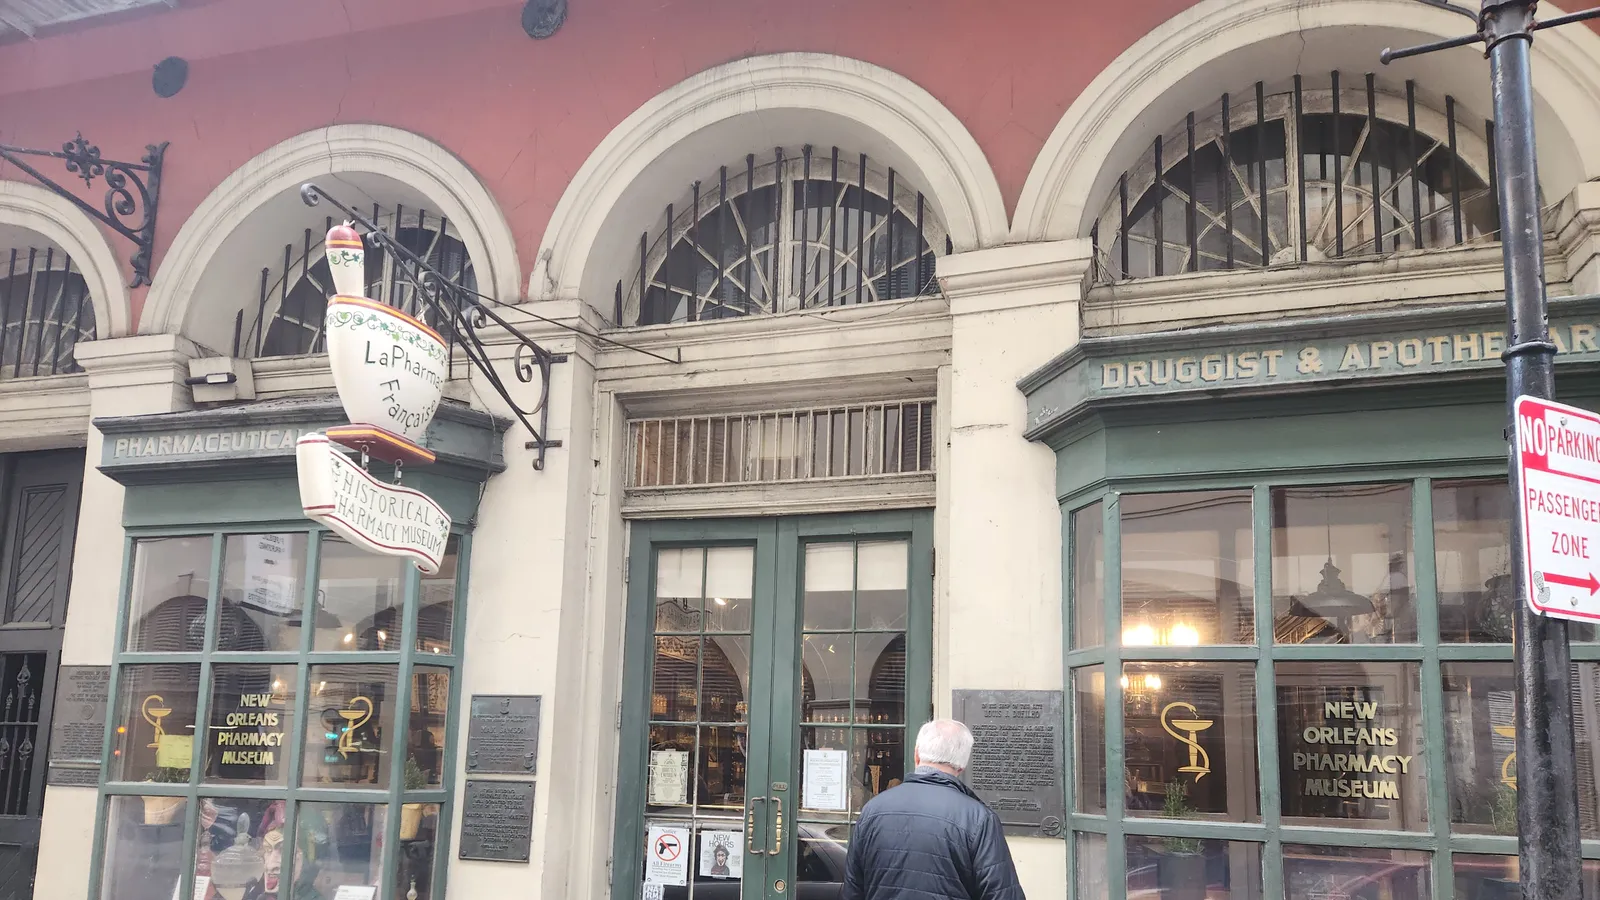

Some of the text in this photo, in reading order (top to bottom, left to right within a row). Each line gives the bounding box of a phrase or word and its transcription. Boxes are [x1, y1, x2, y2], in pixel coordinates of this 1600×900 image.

[1100, 350, 1283, 389] DRUGGIST
[1296, 346, 1323, 374] &
[1519, 413, 1546, 457] NO
[341, 470, 432, 528] HISTORICAL
[1528, 488, 1600, 524] PASSENGE
[333, 490, 442, 556] HARMACY MUSEUM
[1551, 531, 1590, 559] ZONE
[240, 693, 272, 707] NEW
[1324, 701, 1378, 720] NEW
[226, 712, 279, 726] ORLEANS
[218, 732, 285, 747] PHARMACY
[1303, 726, 1399, 747] ORLEANS
[221, 751, 275, 765] MUSEUM
[1293, 752, 1413, 774] PHARMACY
[1304, 778, 1400, 799] MUSEUM
[708, 840, 735, 849] HOURS
